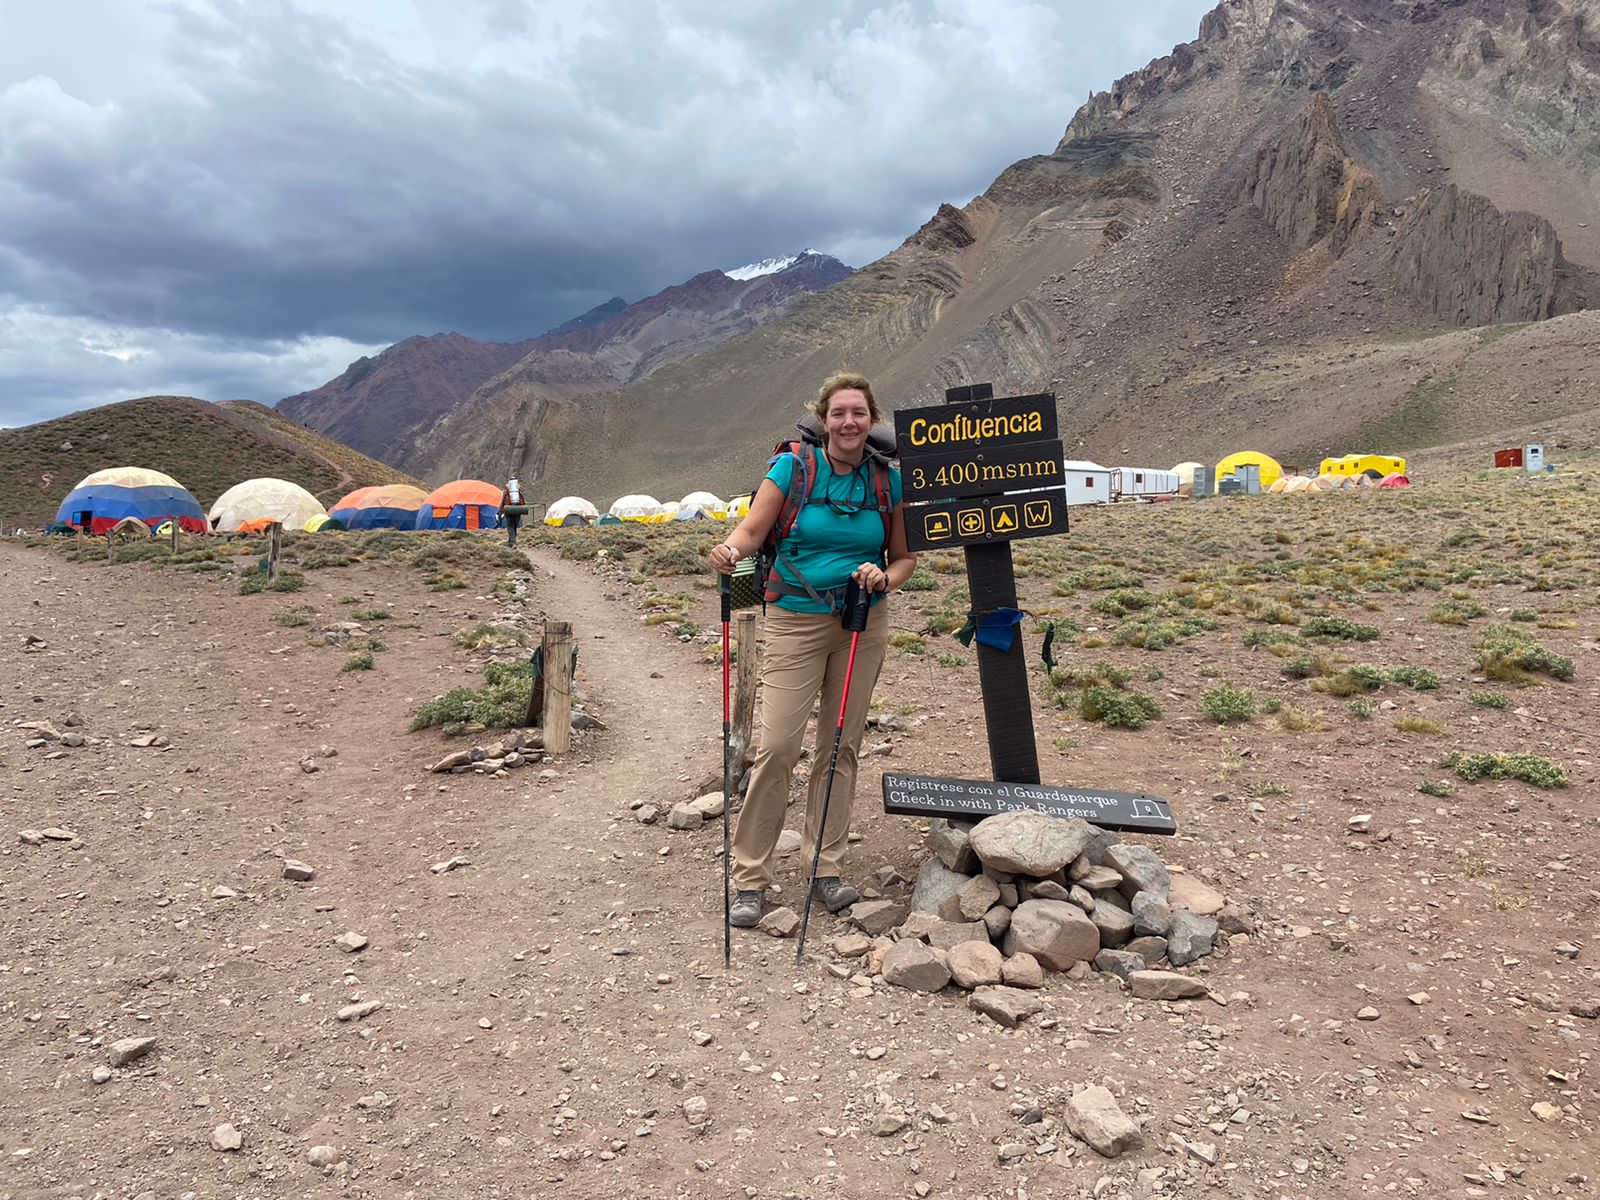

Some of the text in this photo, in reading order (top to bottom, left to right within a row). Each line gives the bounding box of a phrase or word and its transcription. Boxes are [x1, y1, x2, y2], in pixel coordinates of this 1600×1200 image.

[910, 411, 1043, 446] Confluencia
[887, 776, 1119, 809] Registrese con el Guardaparque
[890, 791, 1097, 818] Check in with Park Rangers
